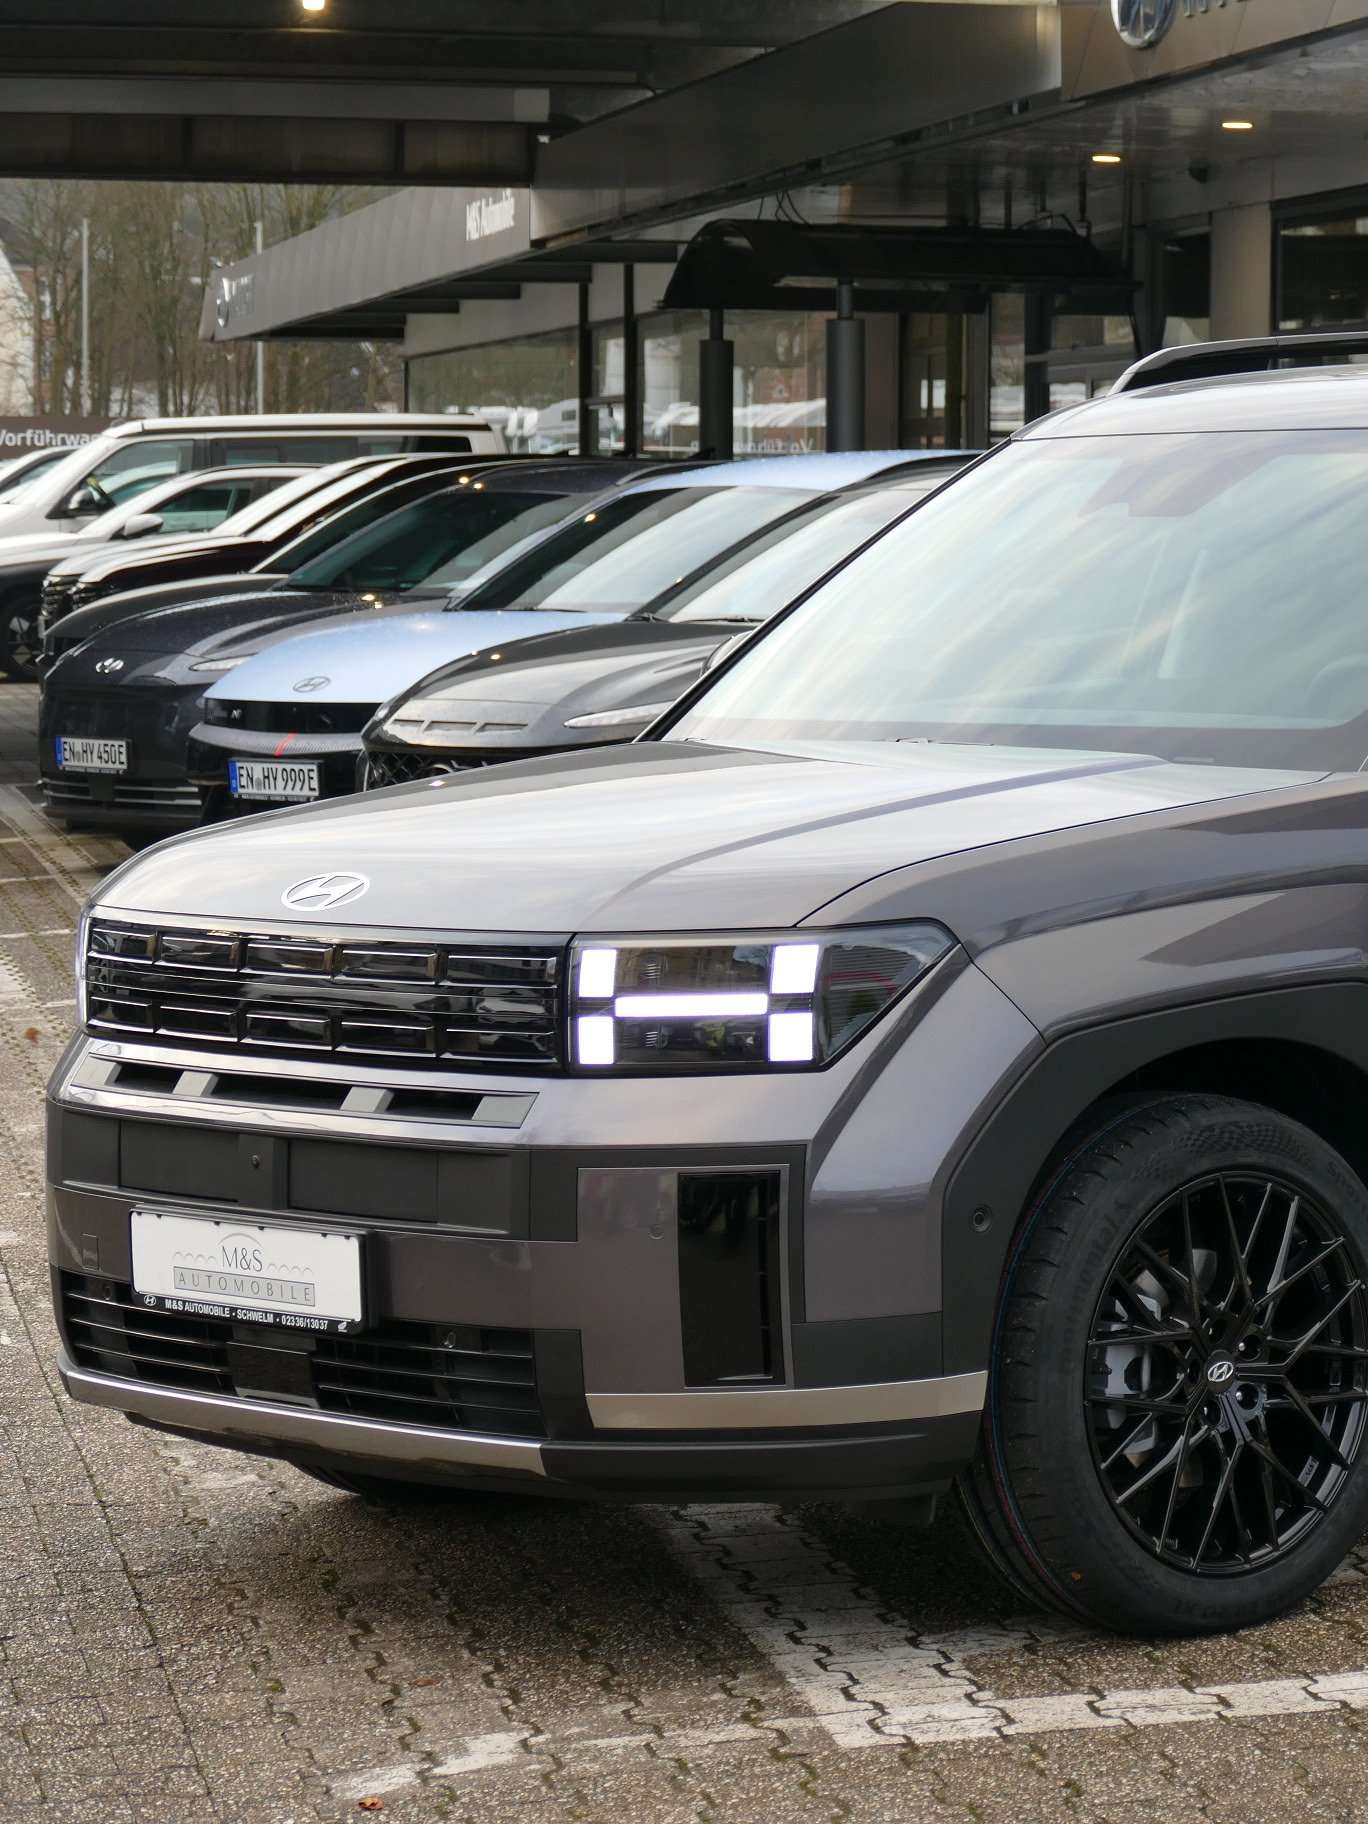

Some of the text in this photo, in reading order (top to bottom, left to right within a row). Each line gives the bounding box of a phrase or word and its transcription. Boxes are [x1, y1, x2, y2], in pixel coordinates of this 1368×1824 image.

[63, 741, 75, 763] EN
[238, 766, 316, 792] EN HY 999E
[222, 1246, 263, 1272] M&S
[178, 1273, 311, 1301] AUTOMOBILE
[165, 1299, 328, 1330] M&S AUTOMOBILE SCHWELM 02336/13037
